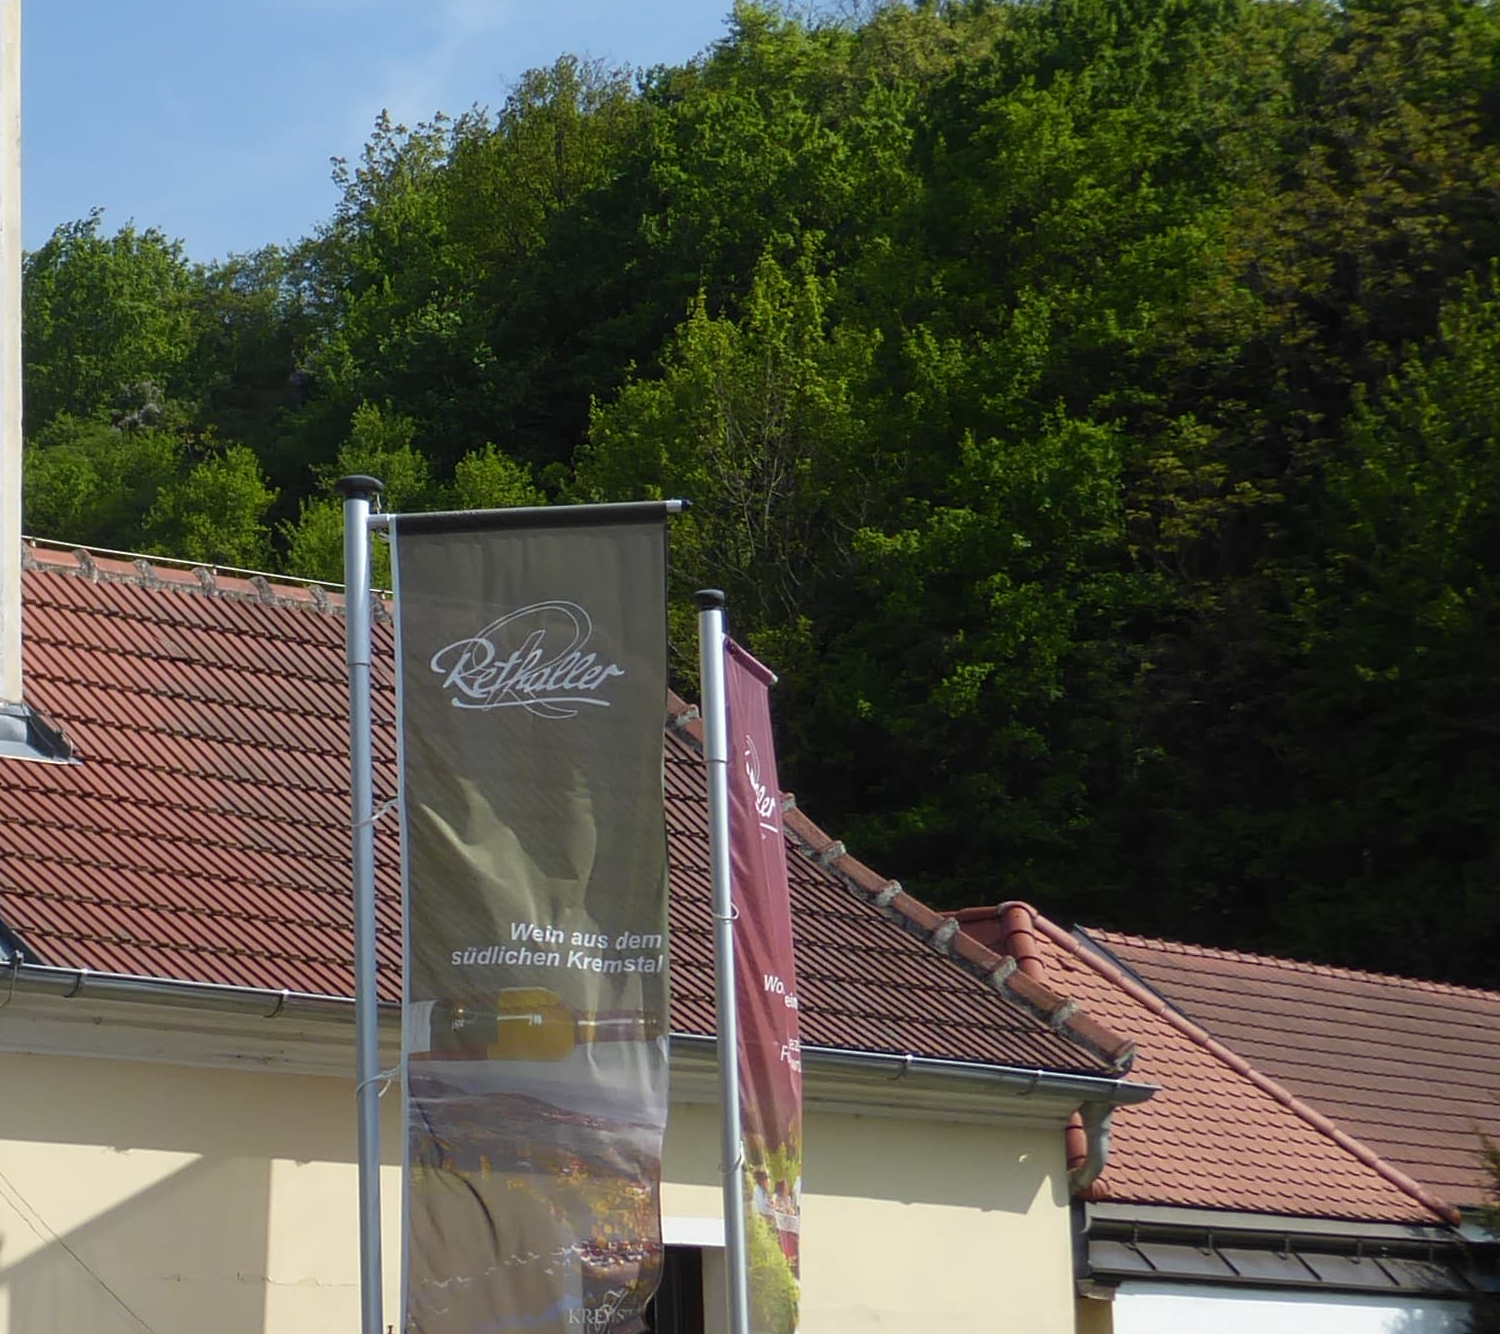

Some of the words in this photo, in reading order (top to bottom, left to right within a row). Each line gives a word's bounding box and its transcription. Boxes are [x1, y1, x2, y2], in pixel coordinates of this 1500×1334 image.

[431, 637, 625, 708] Rethaller
[510, 922, 565, 944] Wein
[571, 931, 609, 950] aus
[615, 931, 663, 950] dem
[451, 946, 561, 968] südlichen
[566, 950, 664, 975] Kremstal
